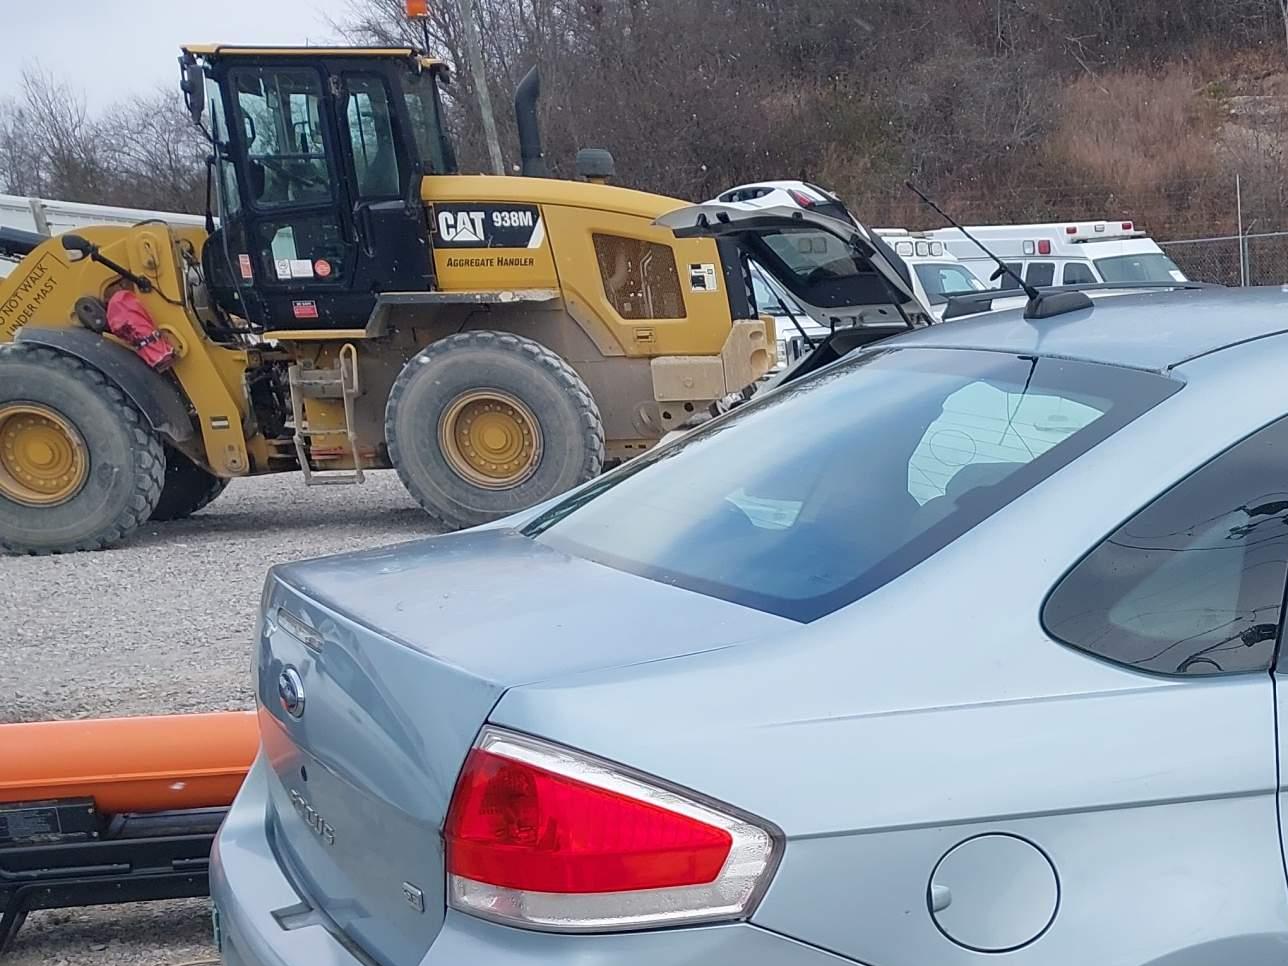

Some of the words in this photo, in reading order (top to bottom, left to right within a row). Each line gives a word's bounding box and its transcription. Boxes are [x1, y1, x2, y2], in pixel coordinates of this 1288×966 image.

[438, 211, 485, 241] CAT
[492, 211, 533, 227] 938M
[3, 292, 24, 317] NOT
[20, 263, 48, 293] WALK
[6, 303, 38, 336] UNDER
[33, 276, 58, 305] MAST
